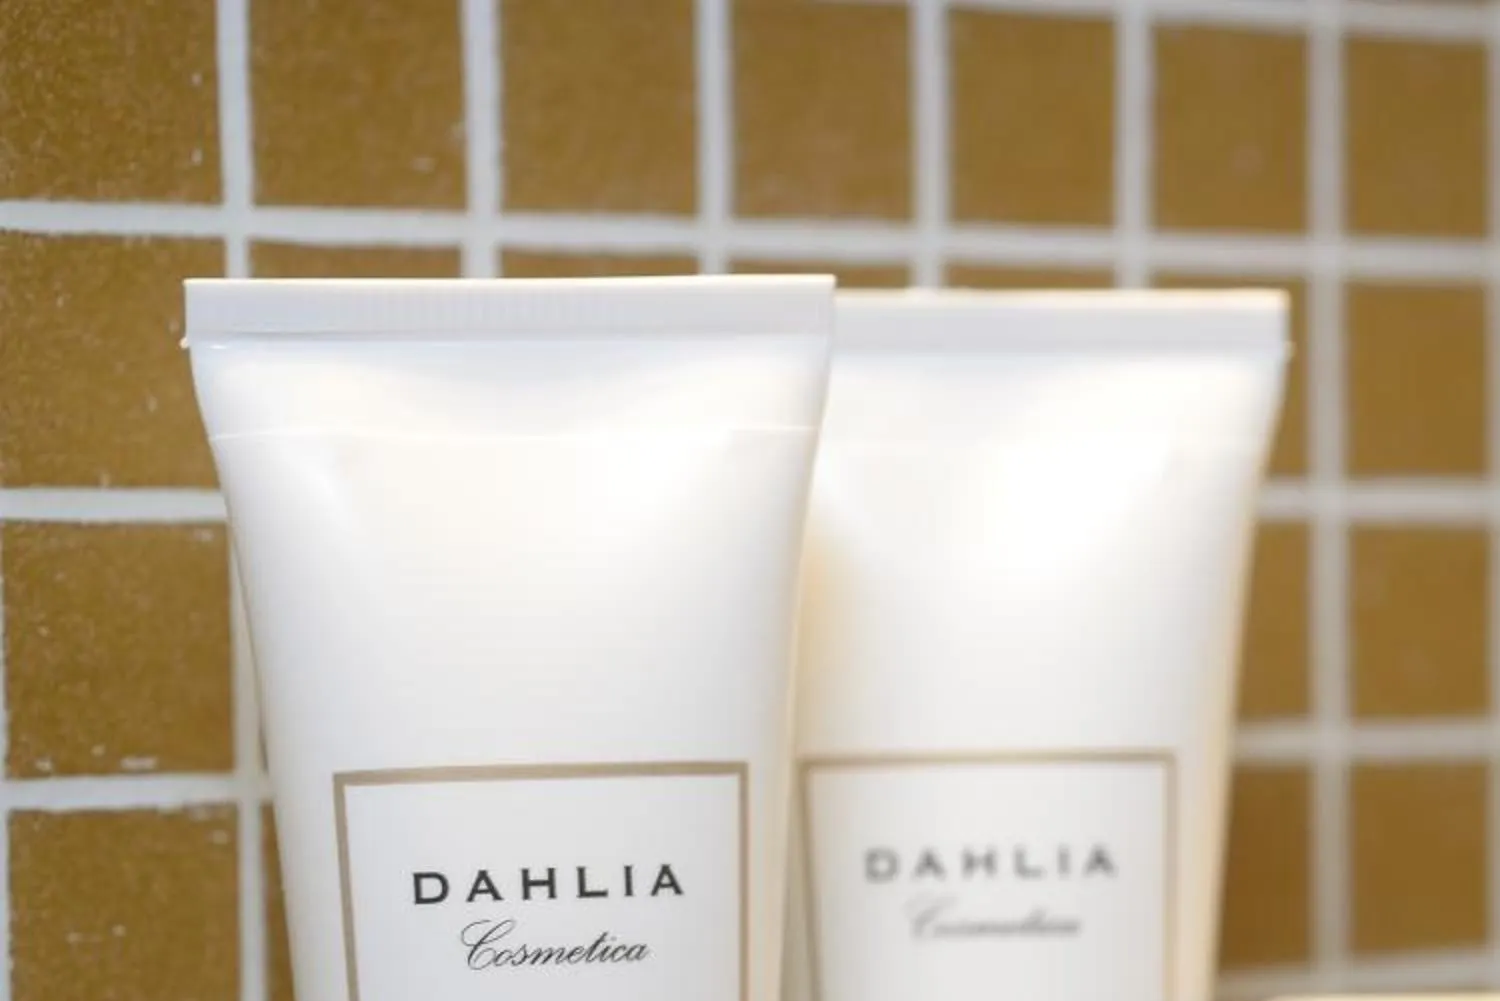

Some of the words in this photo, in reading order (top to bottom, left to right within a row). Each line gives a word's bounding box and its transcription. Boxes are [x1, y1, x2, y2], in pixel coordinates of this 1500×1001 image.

[412, 863, 685, 905] DAHLIA
[864, 843, 1118, 884] DAHLIA
[460, 918, 651, 971] Cosmetica
